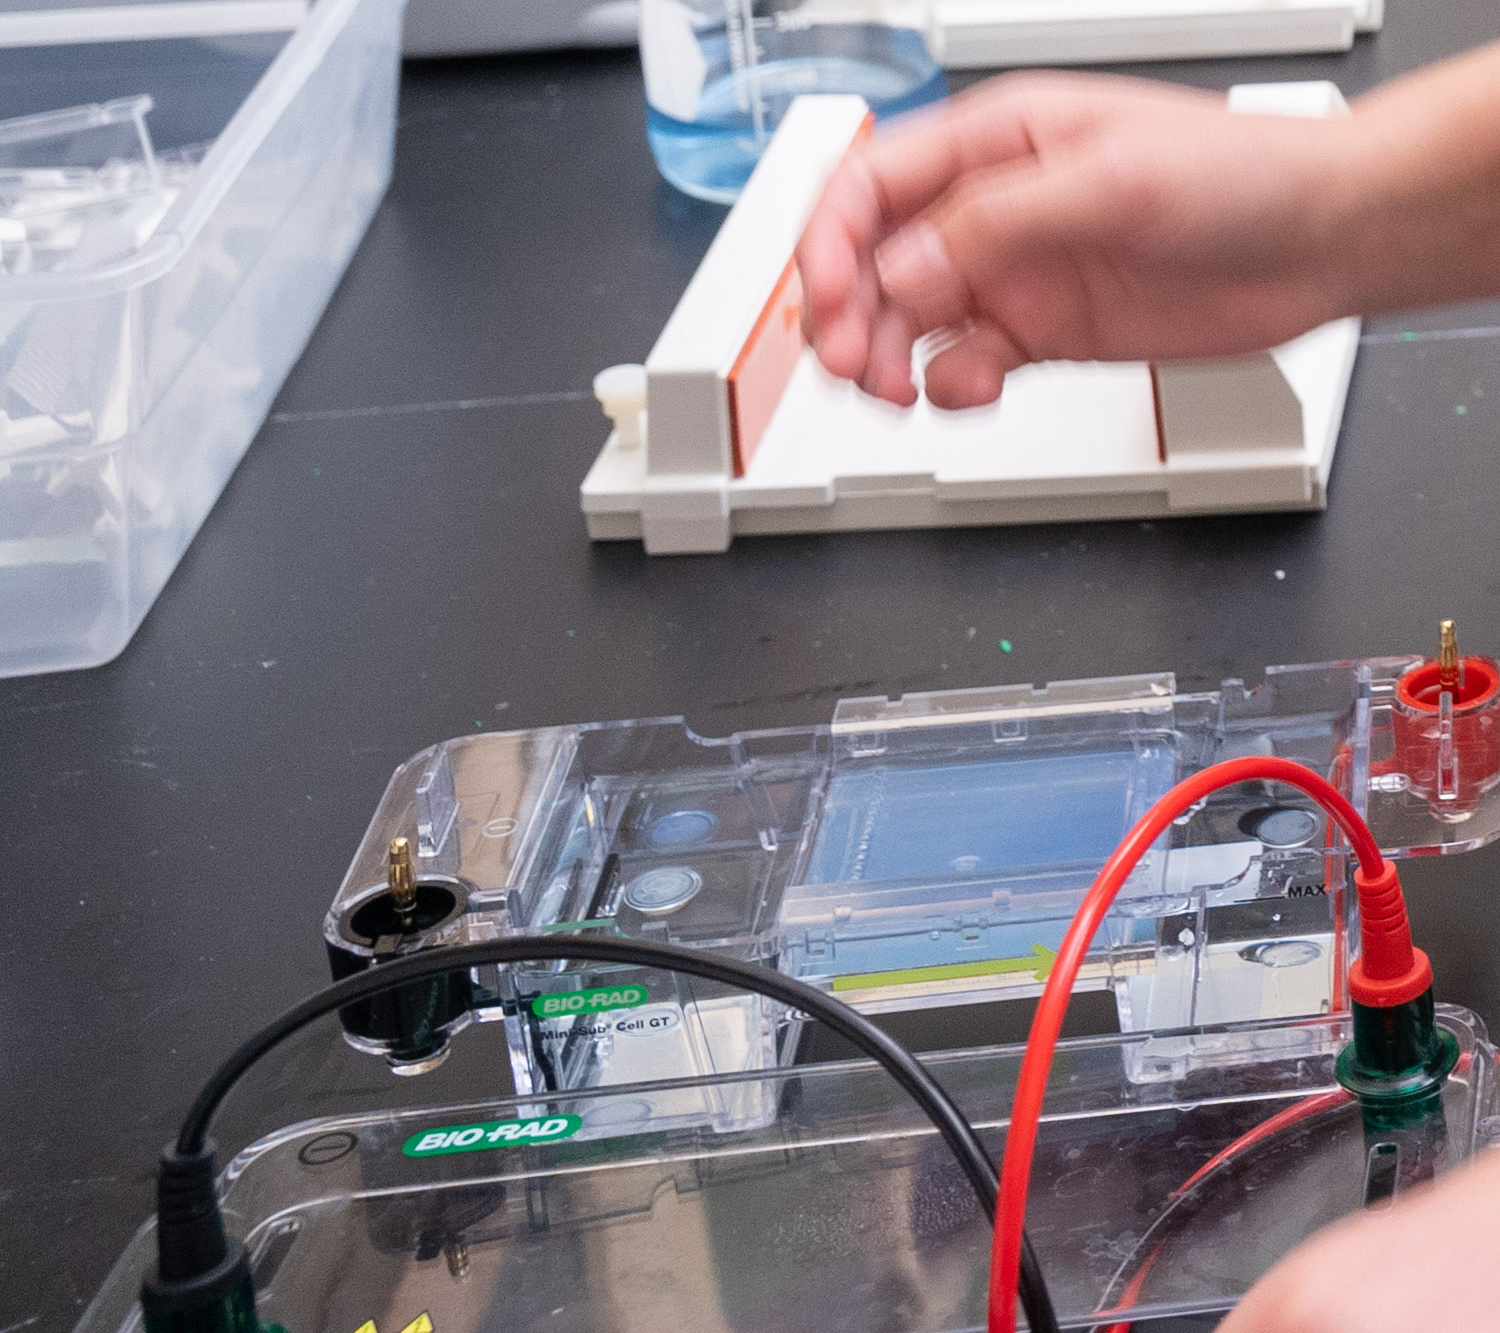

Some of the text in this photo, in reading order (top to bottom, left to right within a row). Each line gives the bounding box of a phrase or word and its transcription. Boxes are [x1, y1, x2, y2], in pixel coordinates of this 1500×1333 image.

[1288, 884, 1327, 898] MAX
[543, 989, 641, 1014] BIO-RAD
[616, 1020, 645, 1032] Cell
[649, 1016, 670, 1028] GT
[414, 1118, 569, 1152] BIO-RAD
